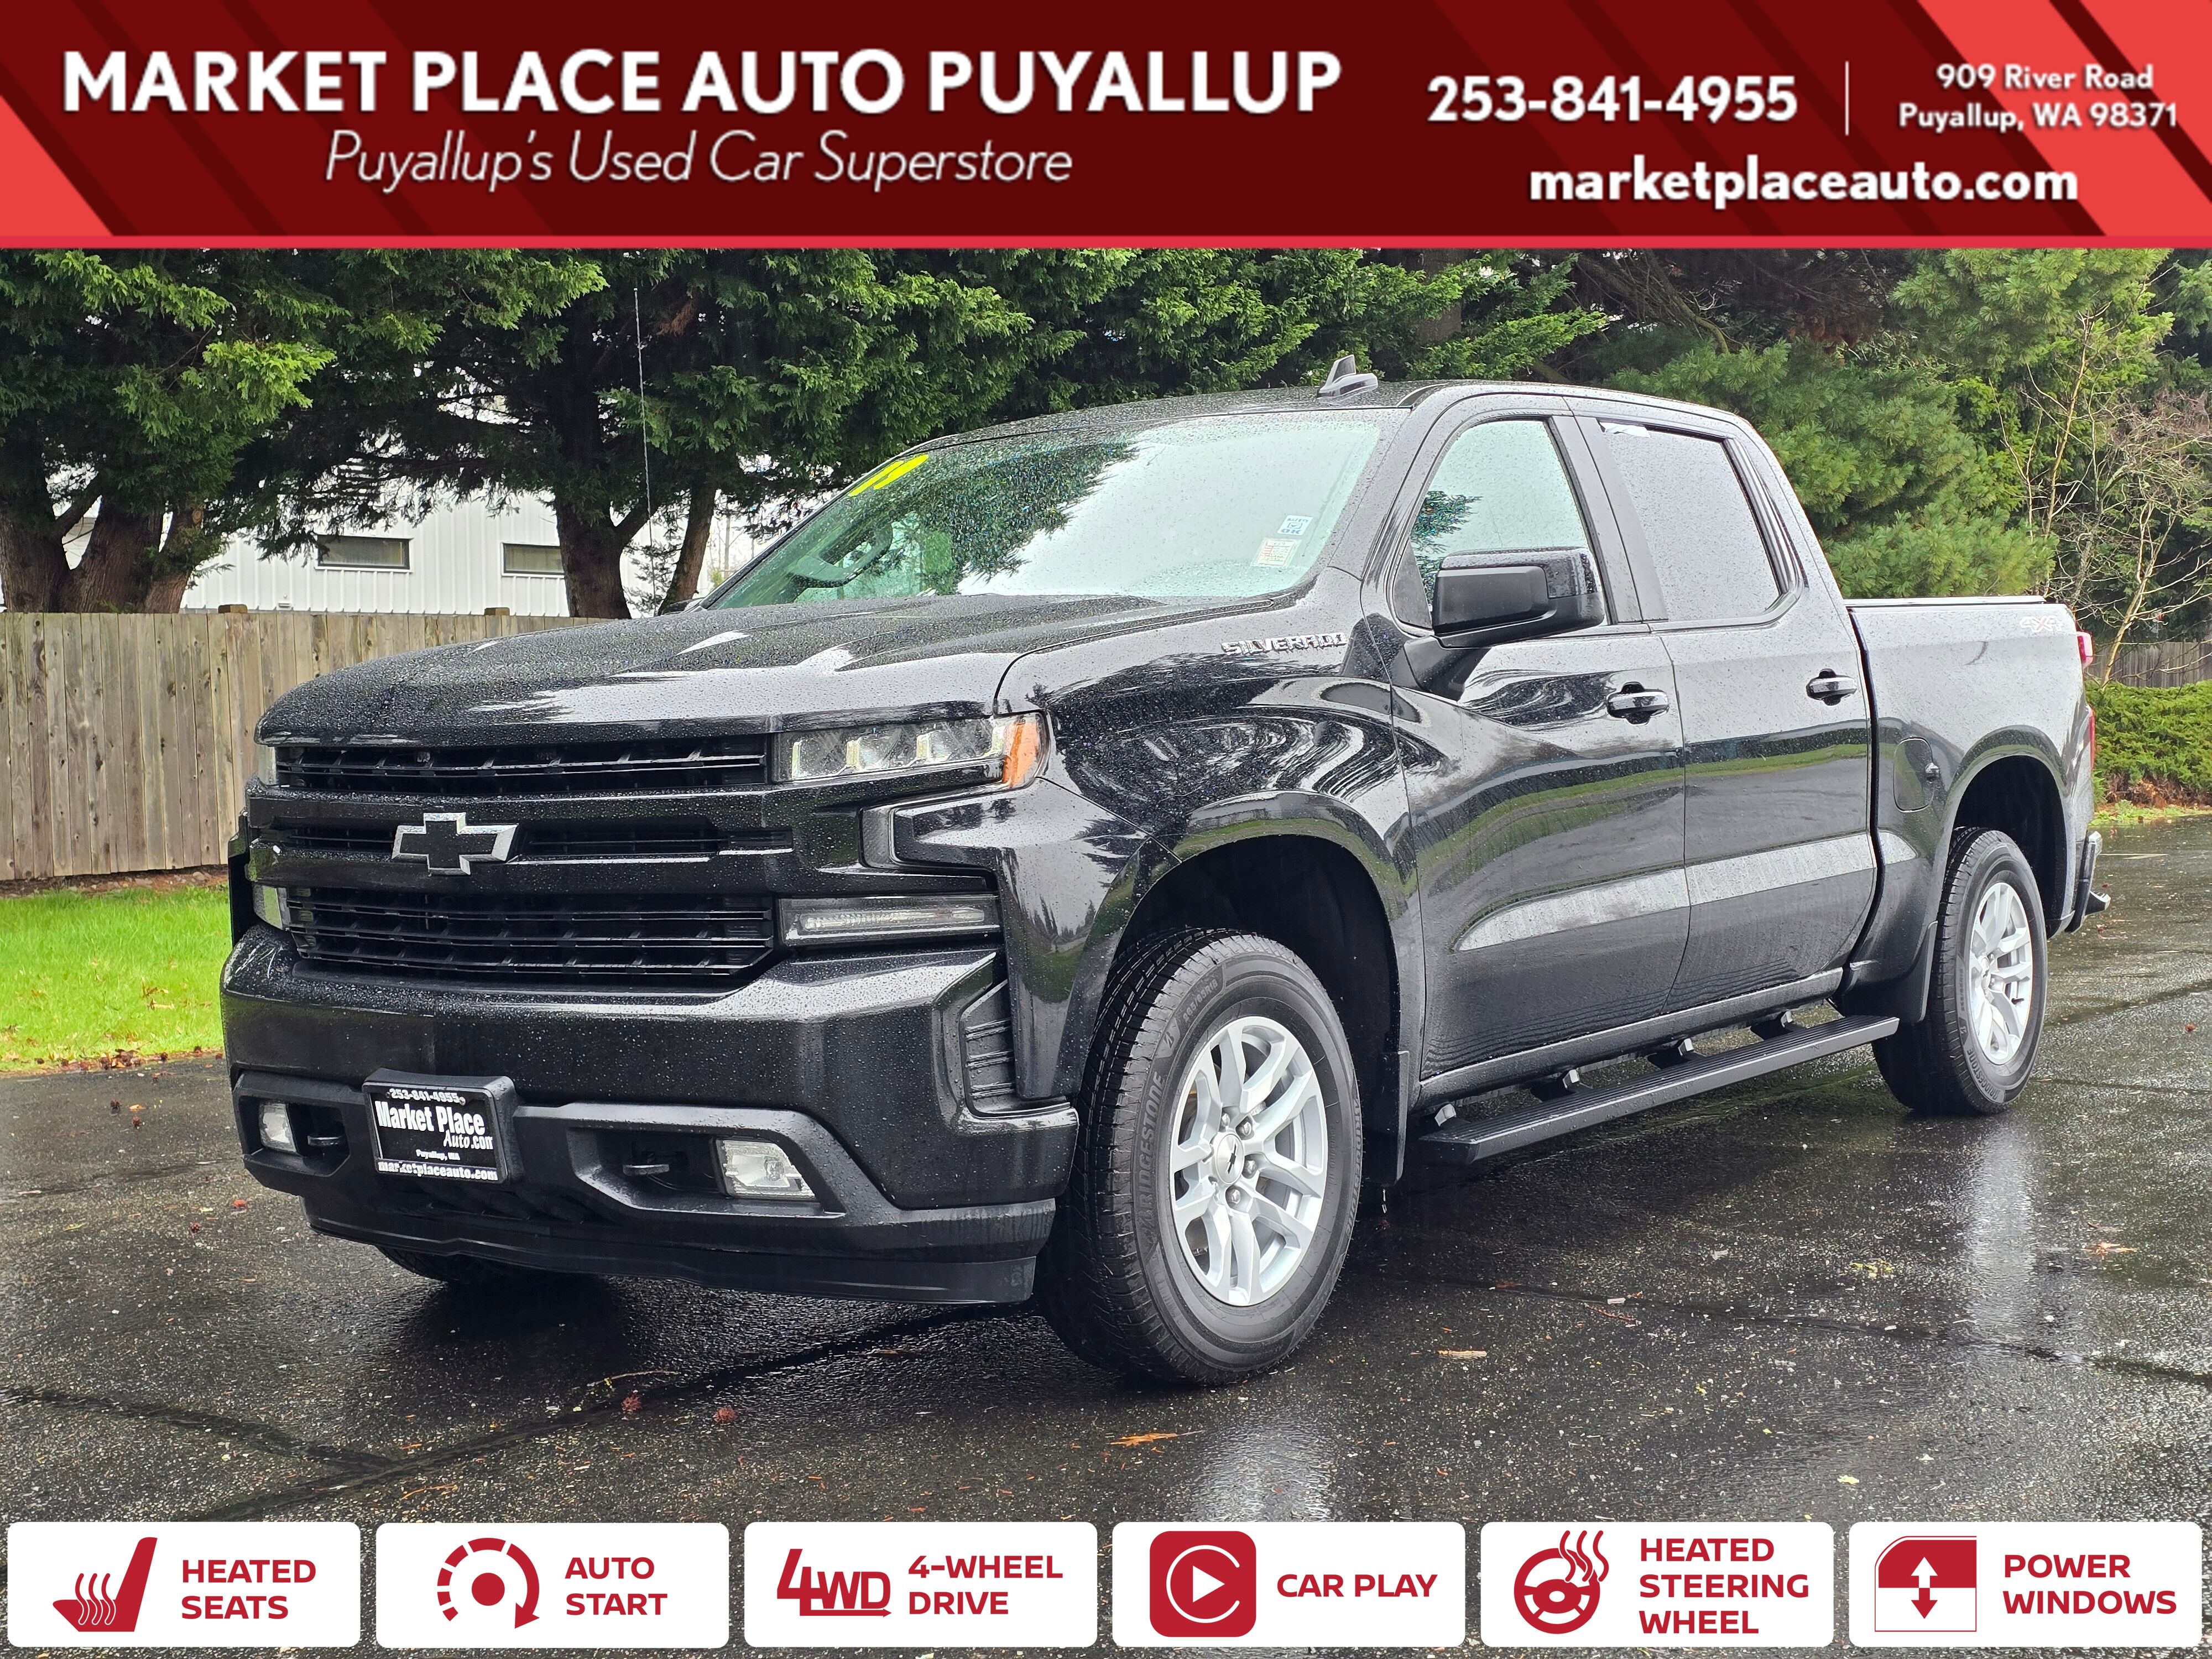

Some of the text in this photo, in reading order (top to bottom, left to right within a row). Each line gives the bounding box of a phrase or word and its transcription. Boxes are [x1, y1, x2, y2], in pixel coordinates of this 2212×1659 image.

[1220, 632, 1348, 656] SILVERADO
[389, 1088, 461, 1104] 253-841-4955
[374, 1100, 486, 1135] Market Place
[1137, 1071, 1165, 1227] BRIDGESTONE
[377, 1161, 498, 1181] marketplaceauto.com
